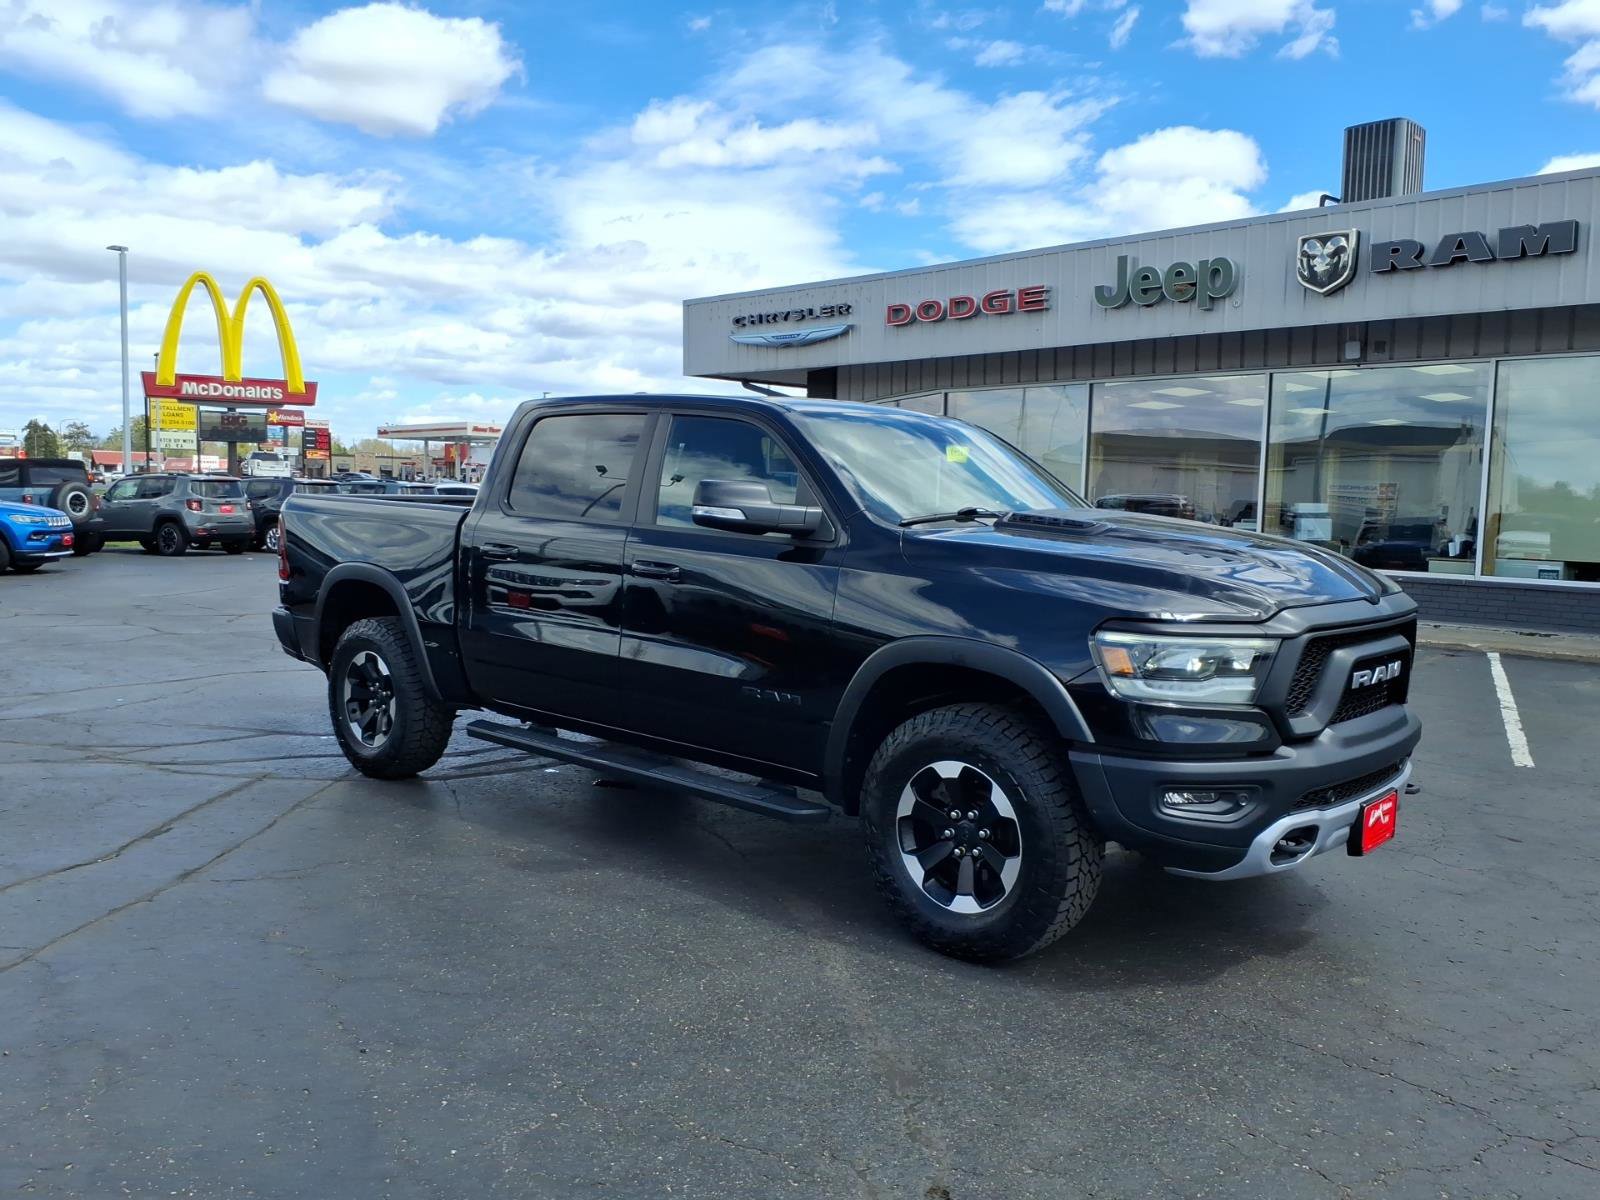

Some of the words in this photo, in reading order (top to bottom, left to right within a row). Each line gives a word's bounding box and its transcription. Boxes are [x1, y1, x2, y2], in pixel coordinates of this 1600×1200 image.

[1370, 219, 1579, 274] RAM
[1095, 254, 1238, 311] Jeep
[732, 302, 853, 328] CHRYSLER
[886, 285, 1051, 326] DODGE
[181, 381, 284, 400] McDonald's
[1352, 660, 1401, 689] RAM
